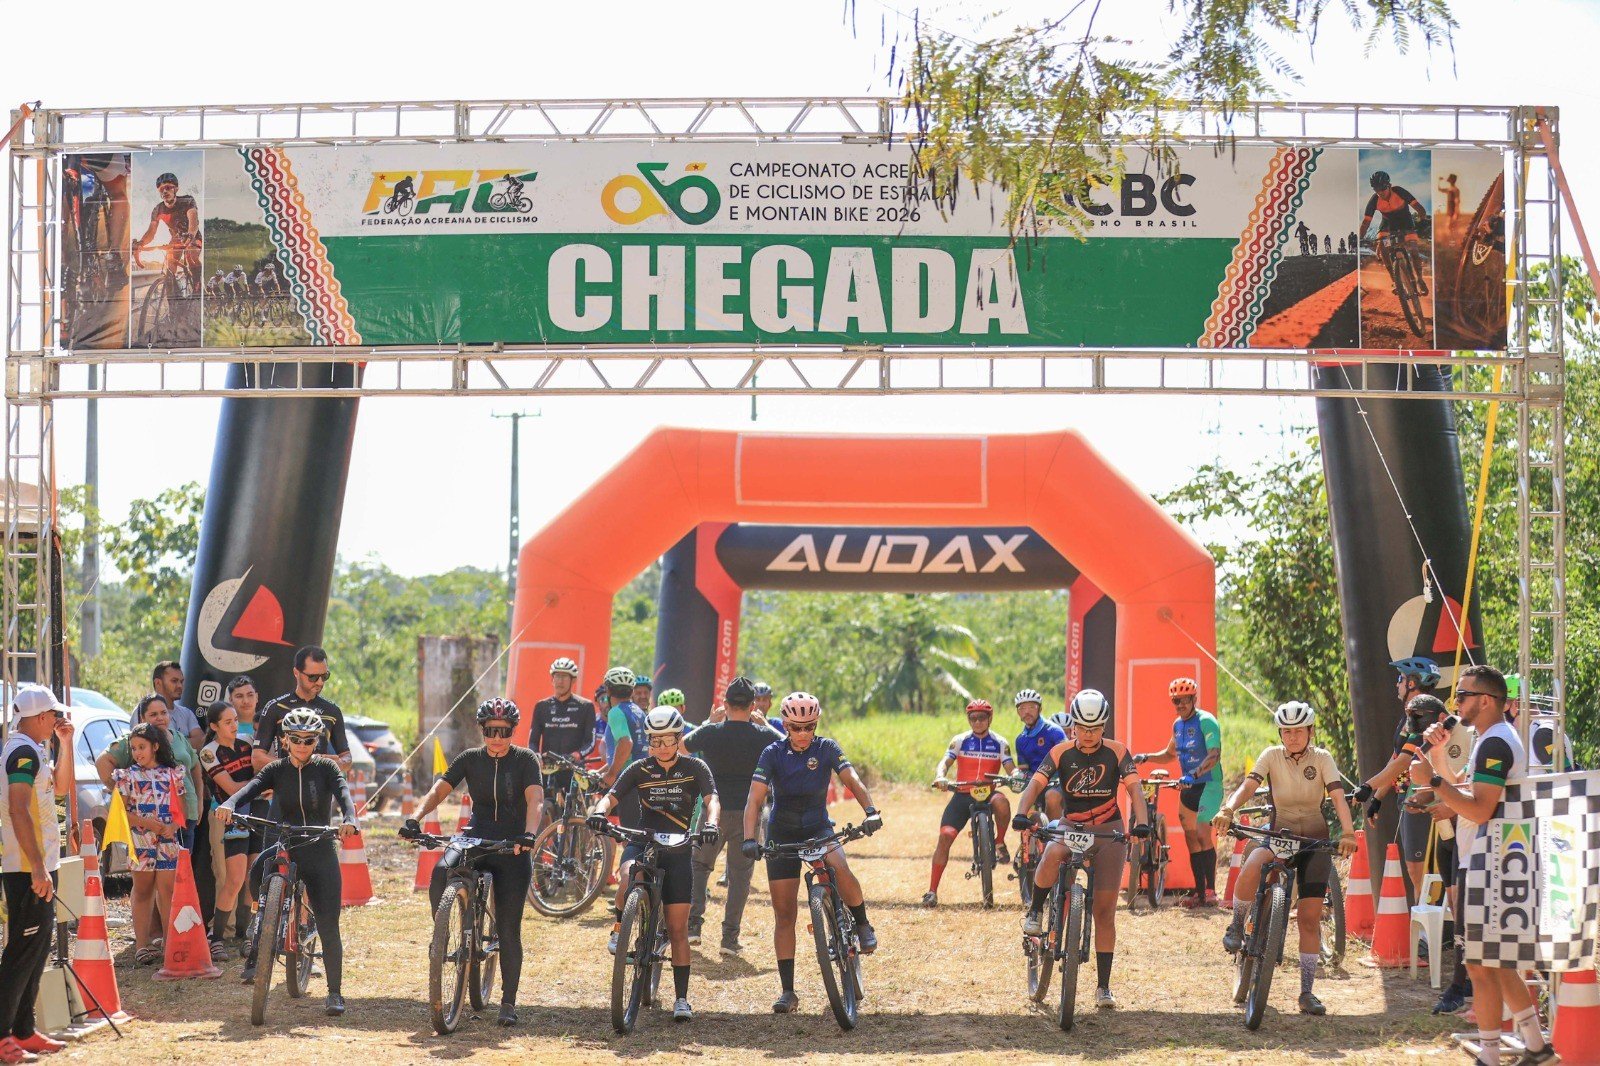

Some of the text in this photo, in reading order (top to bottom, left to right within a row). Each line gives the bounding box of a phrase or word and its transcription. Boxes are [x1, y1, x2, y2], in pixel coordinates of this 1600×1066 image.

[729, 162, 856, 178] CAMPEONATO
[729, 184, 750, 199] DE
[756, 184, 846, 200] CICLISMO
[852, 185, 873, 200] DE
[1080, 173, 1197, 217] CBC
[361, 215, 538, 227] FEDERAÇÃO ACREANA DE CICLISMO
[729, 206, 921, 222] E MONTAIN BIKE 2026
[547, 243, 1030, 335] CHEGADA
[765, 534, 1029, 573] AUDAX
[1069, 833, 1089, 843] 074
[1275, 839, 1293, 850] 071
[1501, 851, 1529, 931] CBC
